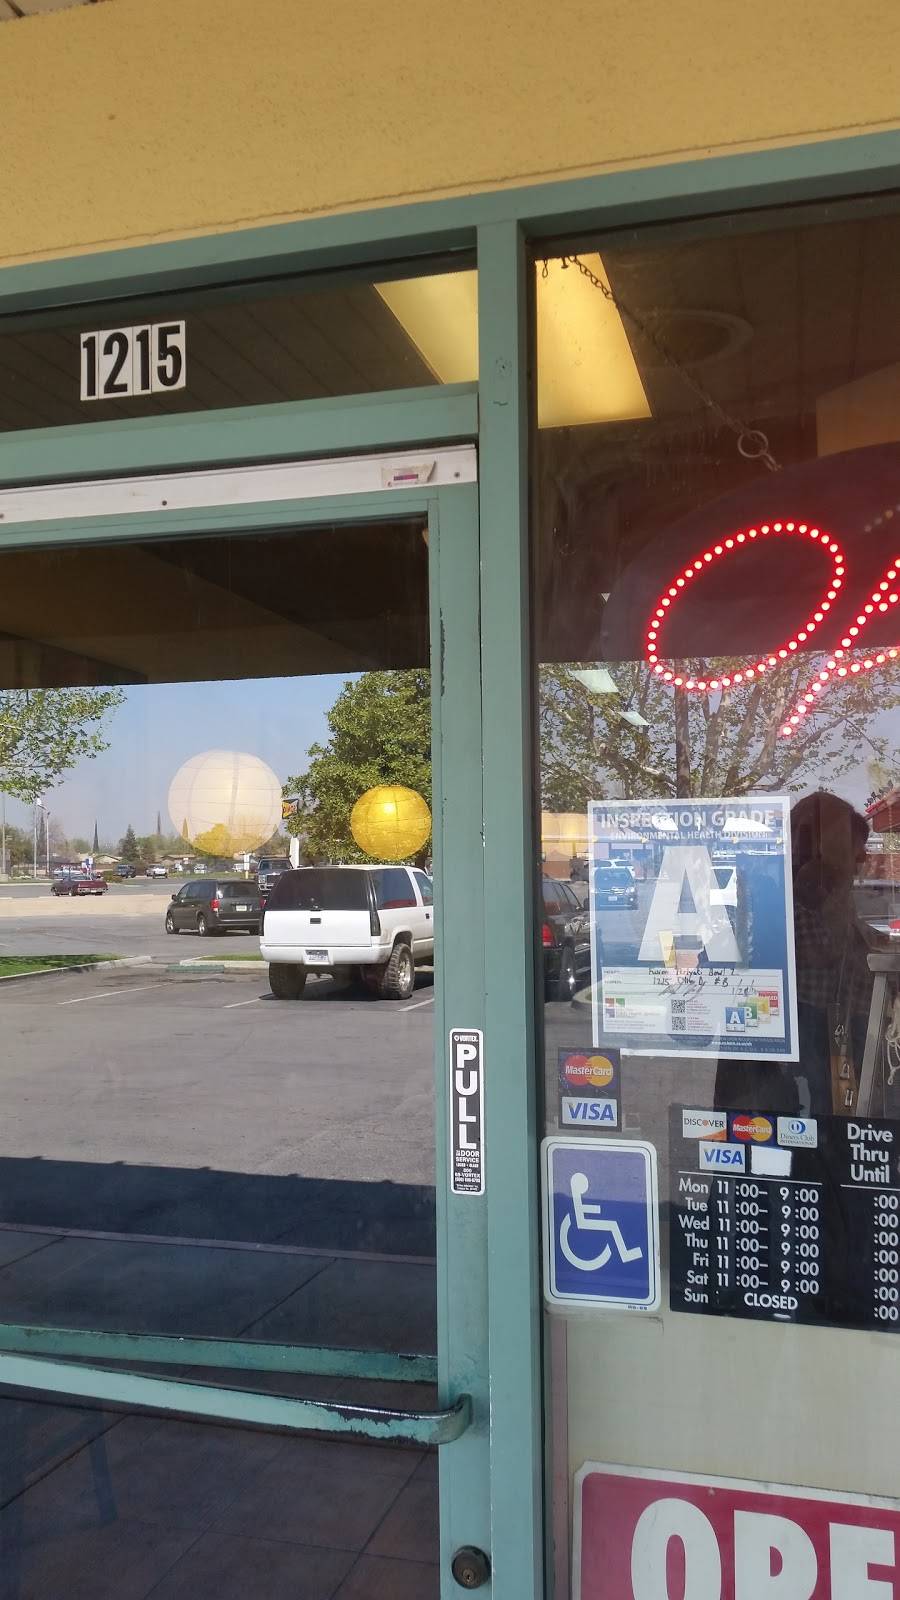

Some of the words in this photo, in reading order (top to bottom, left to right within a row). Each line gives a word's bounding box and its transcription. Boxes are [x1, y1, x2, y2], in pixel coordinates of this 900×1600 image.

[82, 324, 183, 397] 1215
[637, 845, 743, 962] A
[565, 1065, 614, 1077] MasterCard
[455, 1043, 478, 1149] PULL
[567, 1102, 615, 1120] VISA
[683, 1117, 725, 1129] DISCOVER
[732, 1122, 772, 1135] MasterCard
[847, 1123, 893, 1142] Drive
[704, 1149, 743, 1165] VISA
[850, 1144, 889, 1163] Thru
[850, 1163, 890, 1183] Until
[679, 1178, 708, 1193] Mon
[685, 1197, 707, 1211] Tue
[874, 1195, 898, 1209] :00
[679, 1215, 709, 1230] Wed
[874, 1213, 898, 1227] :00
[685, 1233, 708, 1248] Thu
[874, 1232, 898, 1246] :00
[694, 1253, 708, 1266] Fri
[874, 1250, 898, 1264] :00
[687, 1270, 708, 1284] Sat
[874, 1268, 898, 1283] :00
[685, 1288, 708, 1303] Sun
[744, 1293, 798, 1309] CLOSED
[875, 1287, 898, 1301] :00
[874, 1306, 898, 1320] :00
